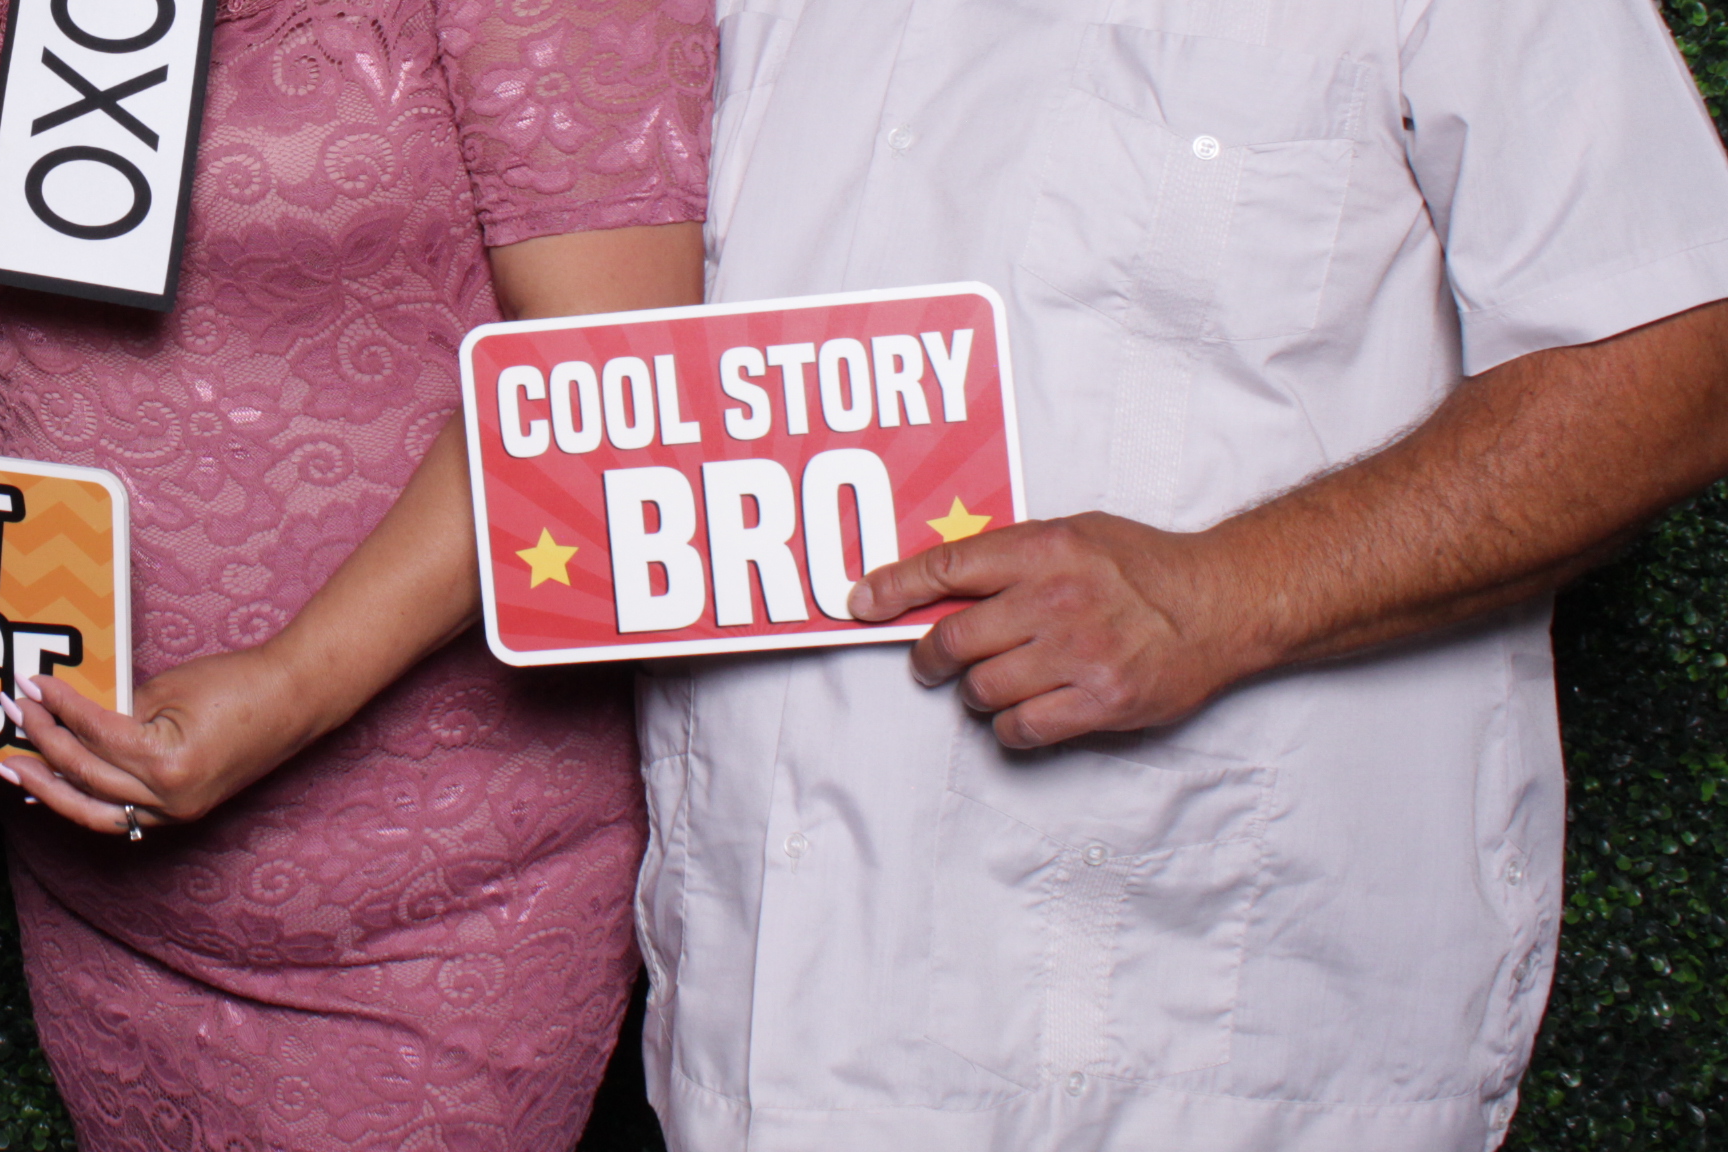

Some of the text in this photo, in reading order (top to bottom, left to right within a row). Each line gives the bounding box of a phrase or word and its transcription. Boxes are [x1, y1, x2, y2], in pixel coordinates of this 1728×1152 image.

[496, 328, 975, 459] COOL STORY
[602, 447, 901, 634] BRO
